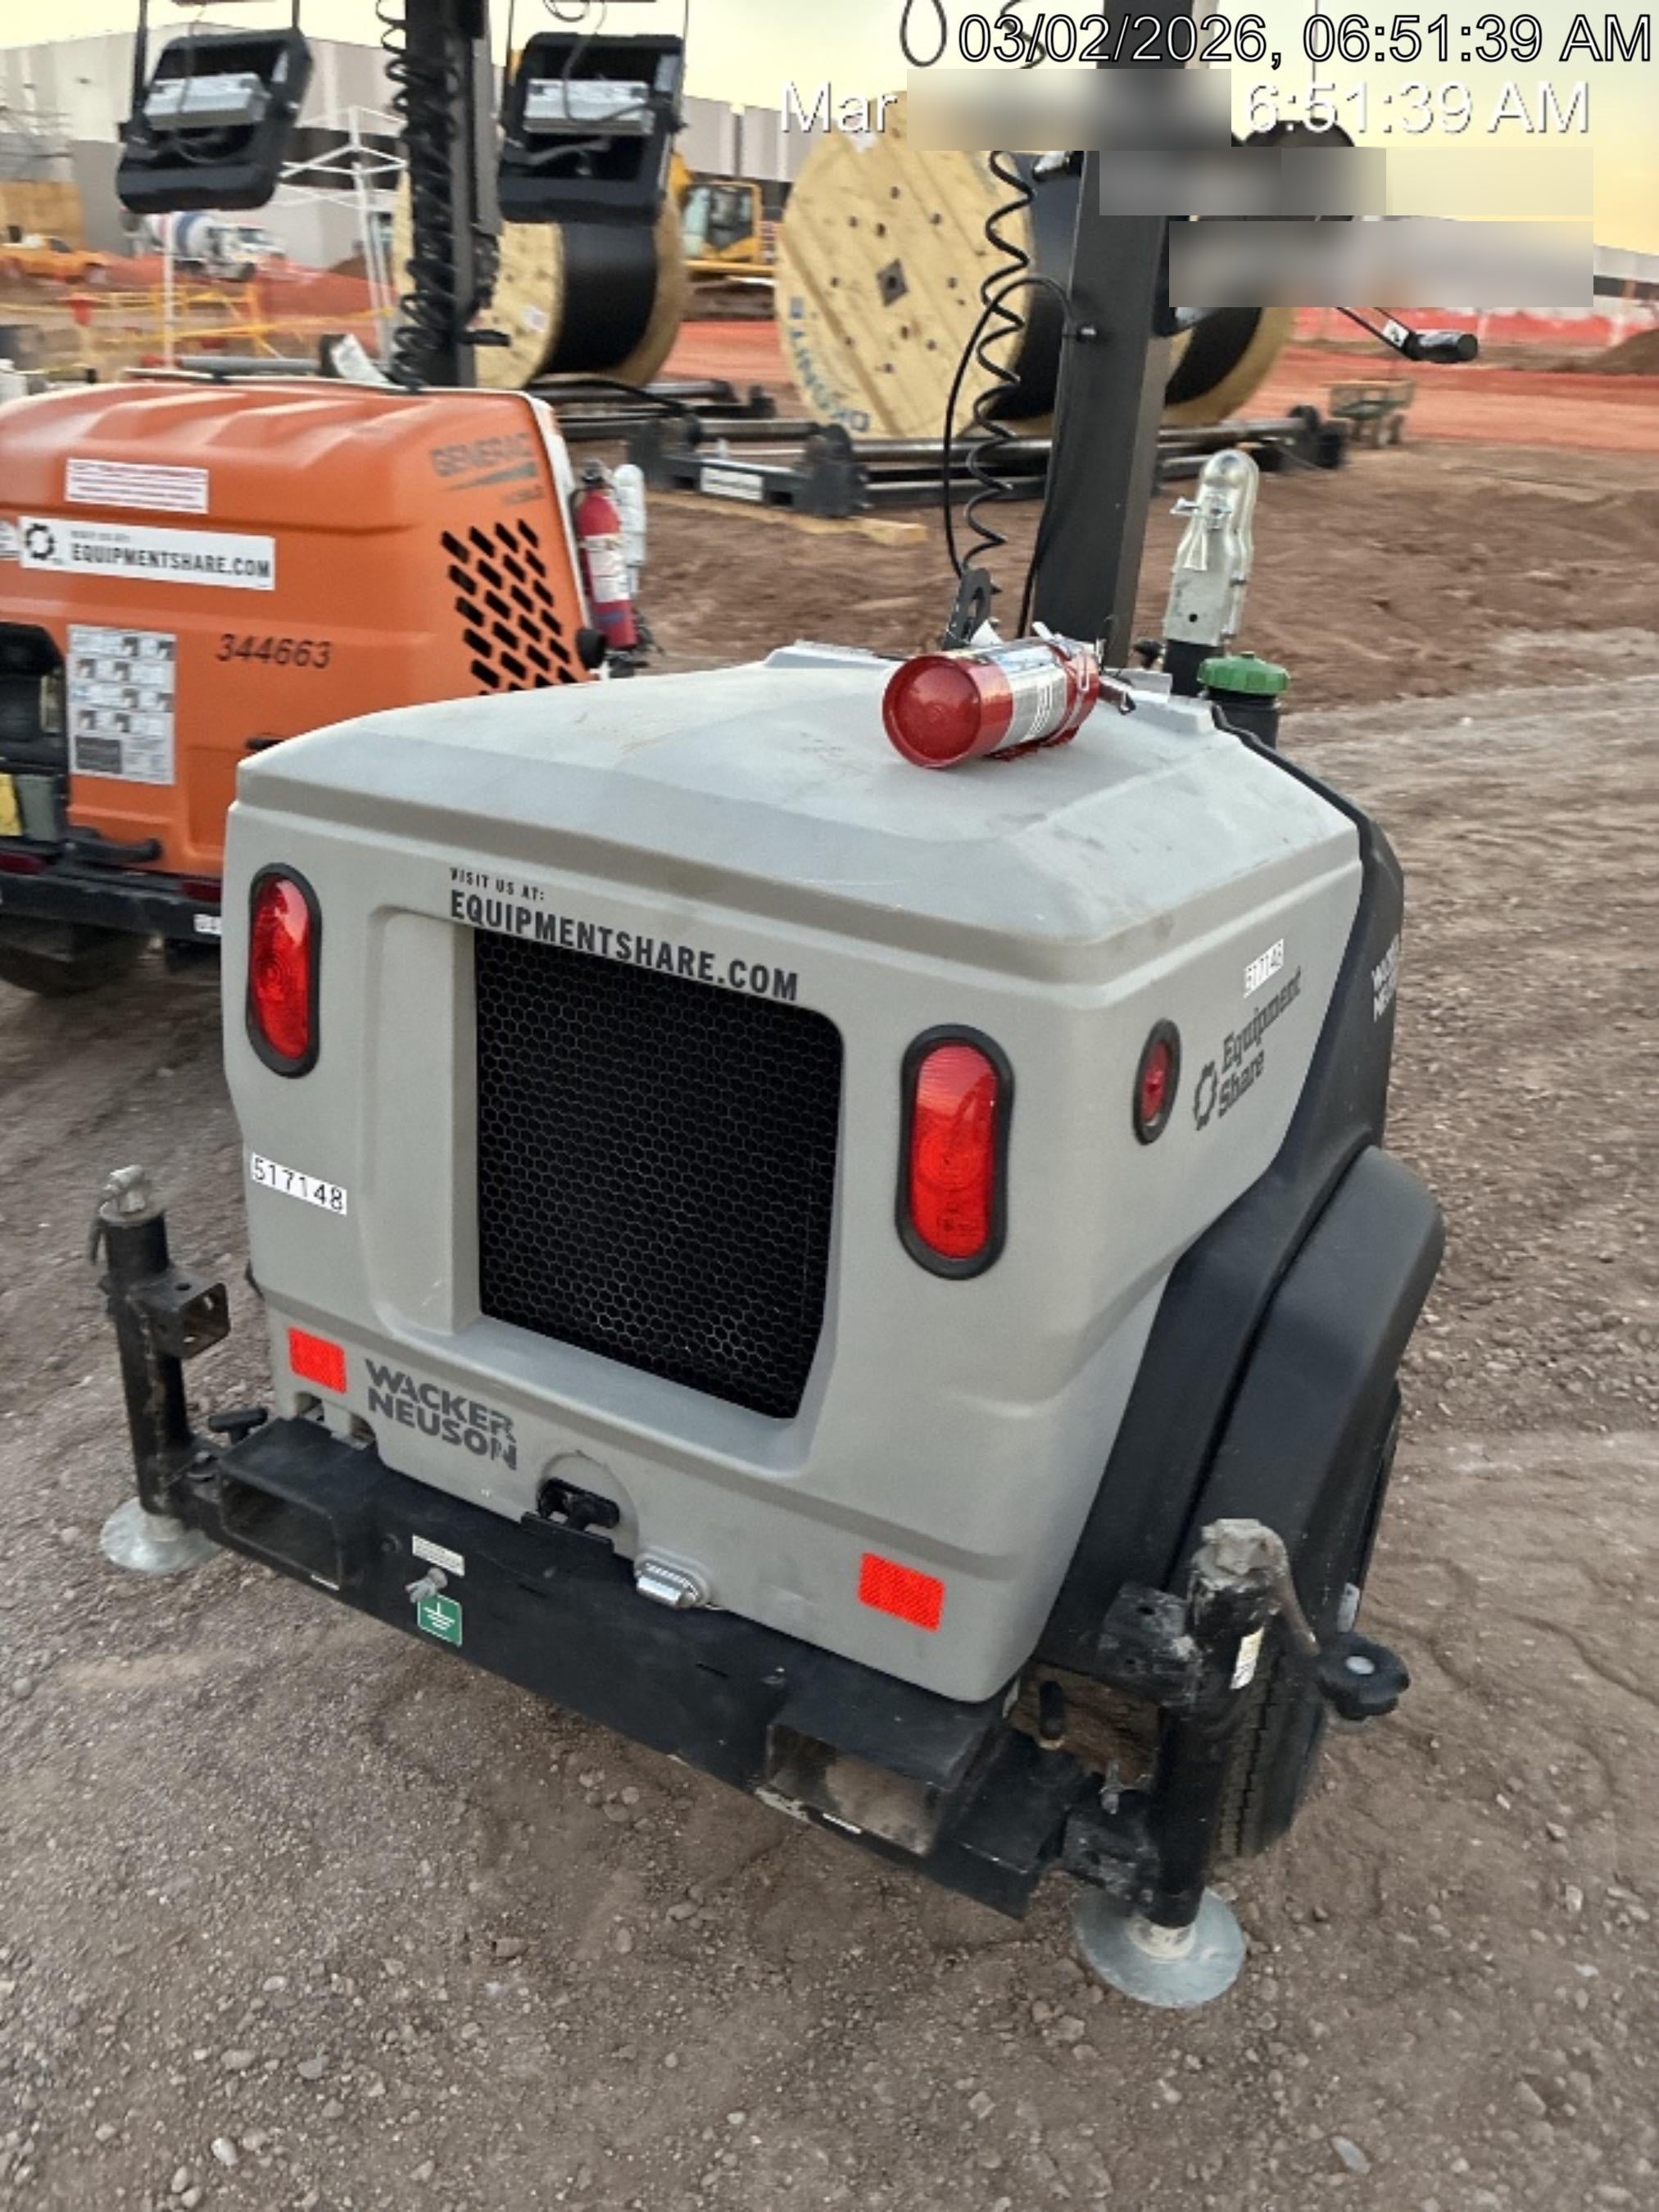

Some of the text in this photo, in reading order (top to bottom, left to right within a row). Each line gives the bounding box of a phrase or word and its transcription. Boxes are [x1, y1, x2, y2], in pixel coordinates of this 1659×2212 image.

[71, 542, 270, 578] EQUIPMENTSHARE.COM
[216, 633, 332, 669] 344663
[450, 867, 545, 901] VISIT US AT:
[451, 889, 800, 1002] EQUIPMENTSHARE.COM
[1222, 965, 1302, 1075] Equipment
[1217, 1049, 1265, 1119] Share
[254, 1156, 343, 1211] 517148
[365, 1358, 517, 1444] WACKER
[368, 1386, 517, 1471] NEUSON
